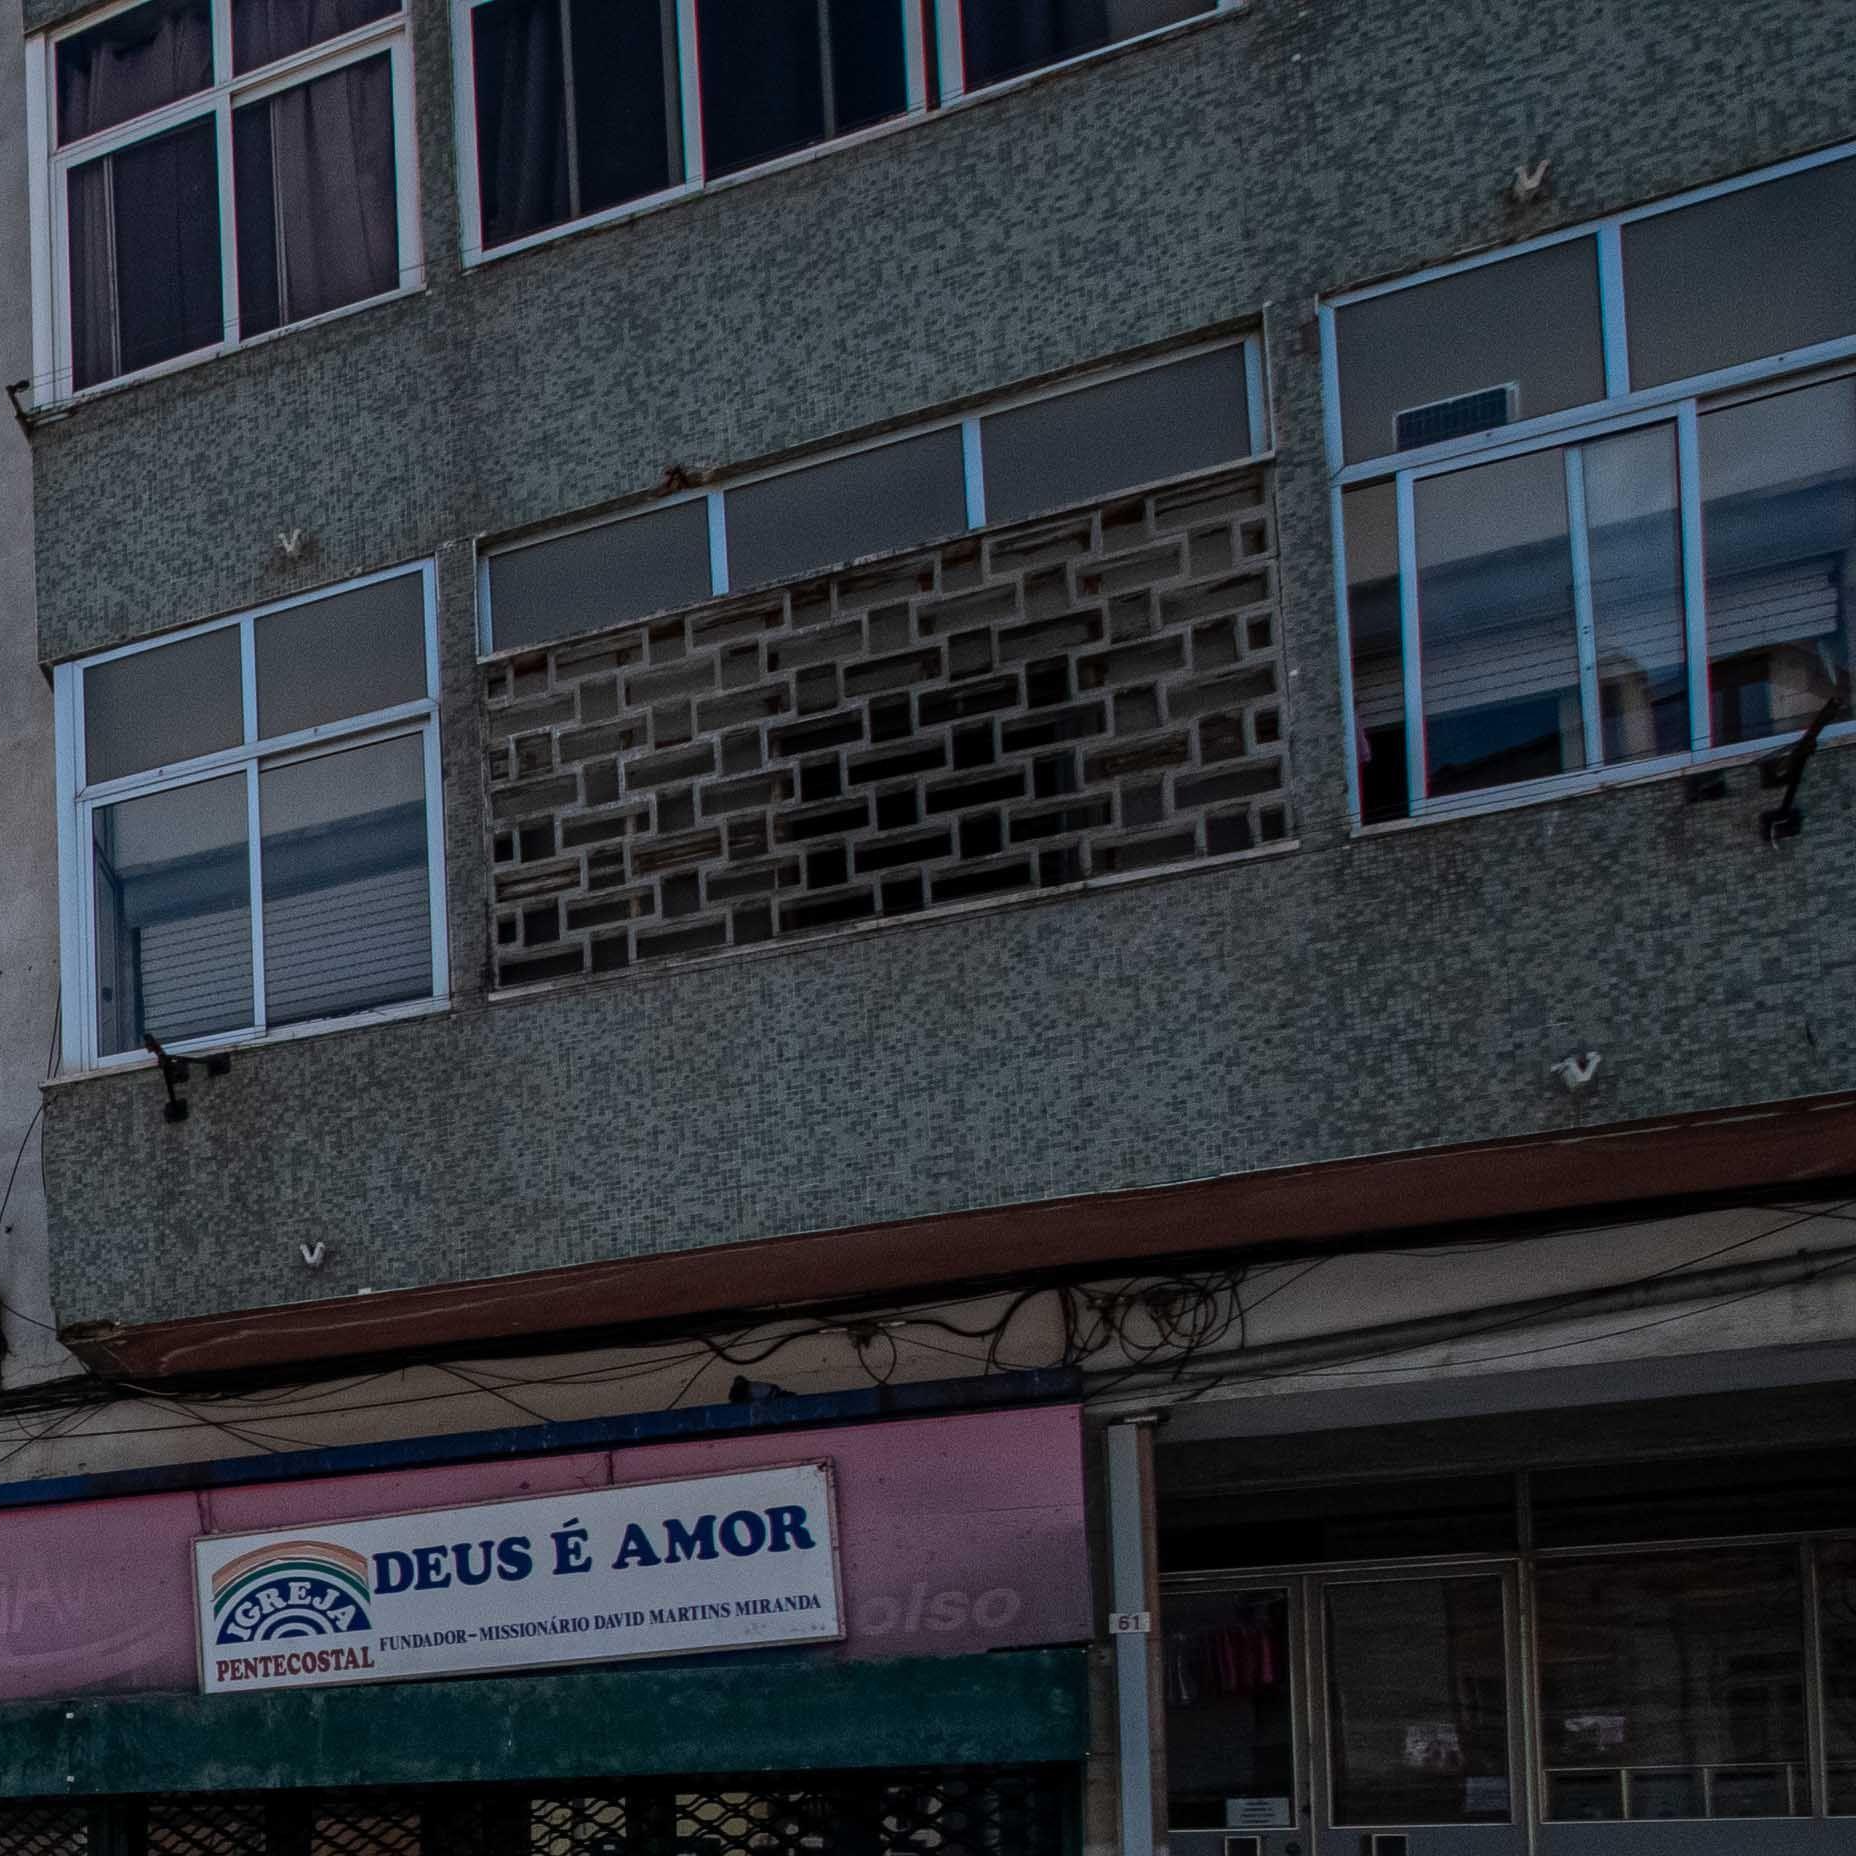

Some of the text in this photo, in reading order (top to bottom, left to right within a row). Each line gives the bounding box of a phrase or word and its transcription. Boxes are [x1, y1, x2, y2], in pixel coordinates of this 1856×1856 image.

[373, 1505, 815, 1594] DEUS É AMOR
[226, 1581, 356, 1641] IGREJA
[593, 1607, 644, 1630] DAVID
[649, 1602, 731, 1627] MARTINS
[735, 1594, 821, 1620] MIRANDA
[1119, 1616, 1139, 1630] 61
[215, 1647, 375, 1682] PENTECOSTAL
